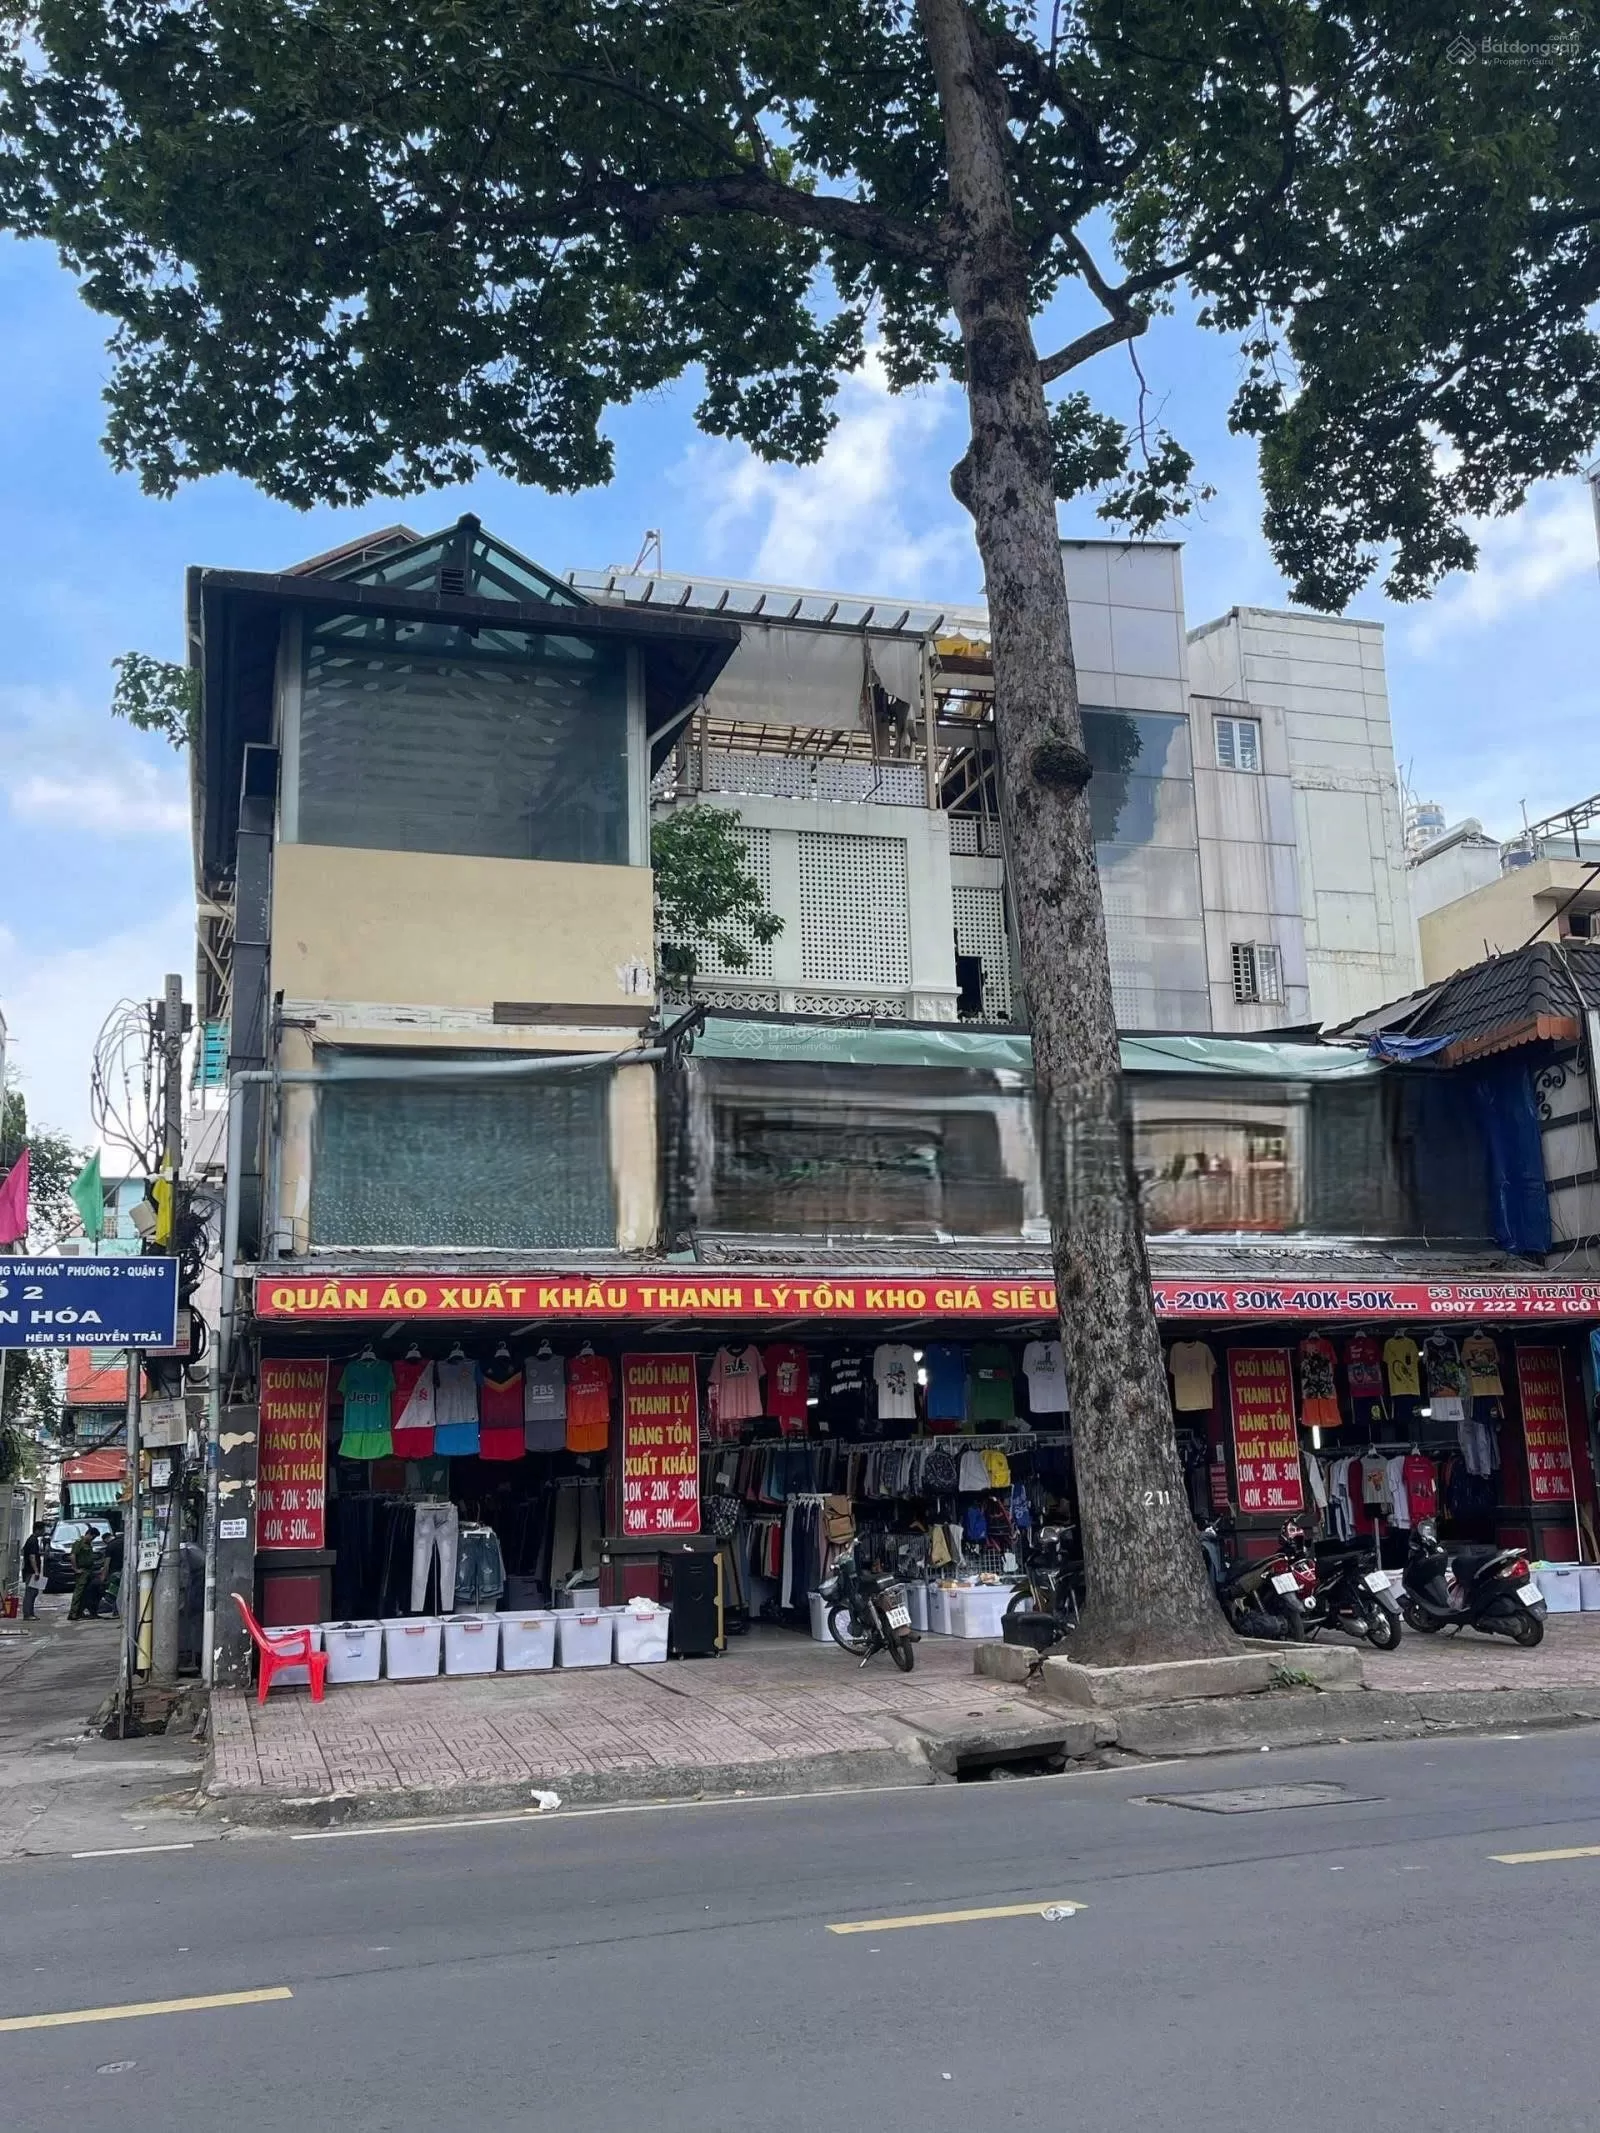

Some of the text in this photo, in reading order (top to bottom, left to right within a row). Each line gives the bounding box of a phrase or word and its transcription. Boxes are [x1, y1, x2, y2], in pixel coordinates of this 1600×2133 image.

[13, 1263, 35, 1276] VĂN
[67, 1264, 110, 1277] PHƯỜNG
[112, 1266, 120, 1277] 2
[127, 1265, 156, 1279] QUẬN
[157, 1266, 165, 1277] 5
[22, 1286, 44, 1300] 2
[271, 1280, 368, 1313] QUẦN
[379, 1282, 428, 1309] ÁO
[438, 1280, 526, 1309] XUẤT
[637, 1287, 742, 1309] THANH
[866, 1288, 927, 1310] KHO
[935, 1283, 982, 1309] GIÁ
[992, 1285, 1057, 1310] SIÊU
[1428, 1286, 1452, 1299] 53
[1457, 1284, 1530, 1299] NGUYỄN
[30, 1306, 102, 1324] HÓA
[1430, 1301, 1475, 1312] 0907
[1482, 1301, 1517, 1312] 222
[1522, 1301, 1556, 1312] 742
[57, 1333, 71, 1342] 51
[75, 1329, 129, 1342] NGUYỄN
[628, 1361, 658, 1385] CUỐI
[349, 1391, 378, 1405] Jeep
[532, 1384, 554, 1396] FBS
[1236, 1383, 1288, 1404] THANH LÝ
[267, 1397, 322, 1420] THANH LÝ
[628, 1391, 690, 1415] THANH LÝ
[629, 1418, 692, 1446] HÀNG TỒN
[1239, 1411, 1269, 1432] HÀNG
[264, 1428, 297, 1450] HÀNG
[1237, 1432, 1297, 1460] XUẤT KHẨU
[260, 1456, 290, 1481] XUẤT
[625, 1446, 696, 1476] XUẤT KHẨU
[1239, 1465, 1254, 1482] 10K
[1262, 1464, 1278, 1482] 20K
[1283, 1463, 1299, 1481] 30K
[281, 1489, 299, 1510] 20K
[624, 1482, 642, 1501] 10K
[651, 1481, 670, 1500] 20K
[678, 1480, 697, 1500] 30K
[1144, 1490, 1170, 1506] 211
[1244, 1489, 1261, 1506] 40K
[264, 1520, 283, 1541] 40K
